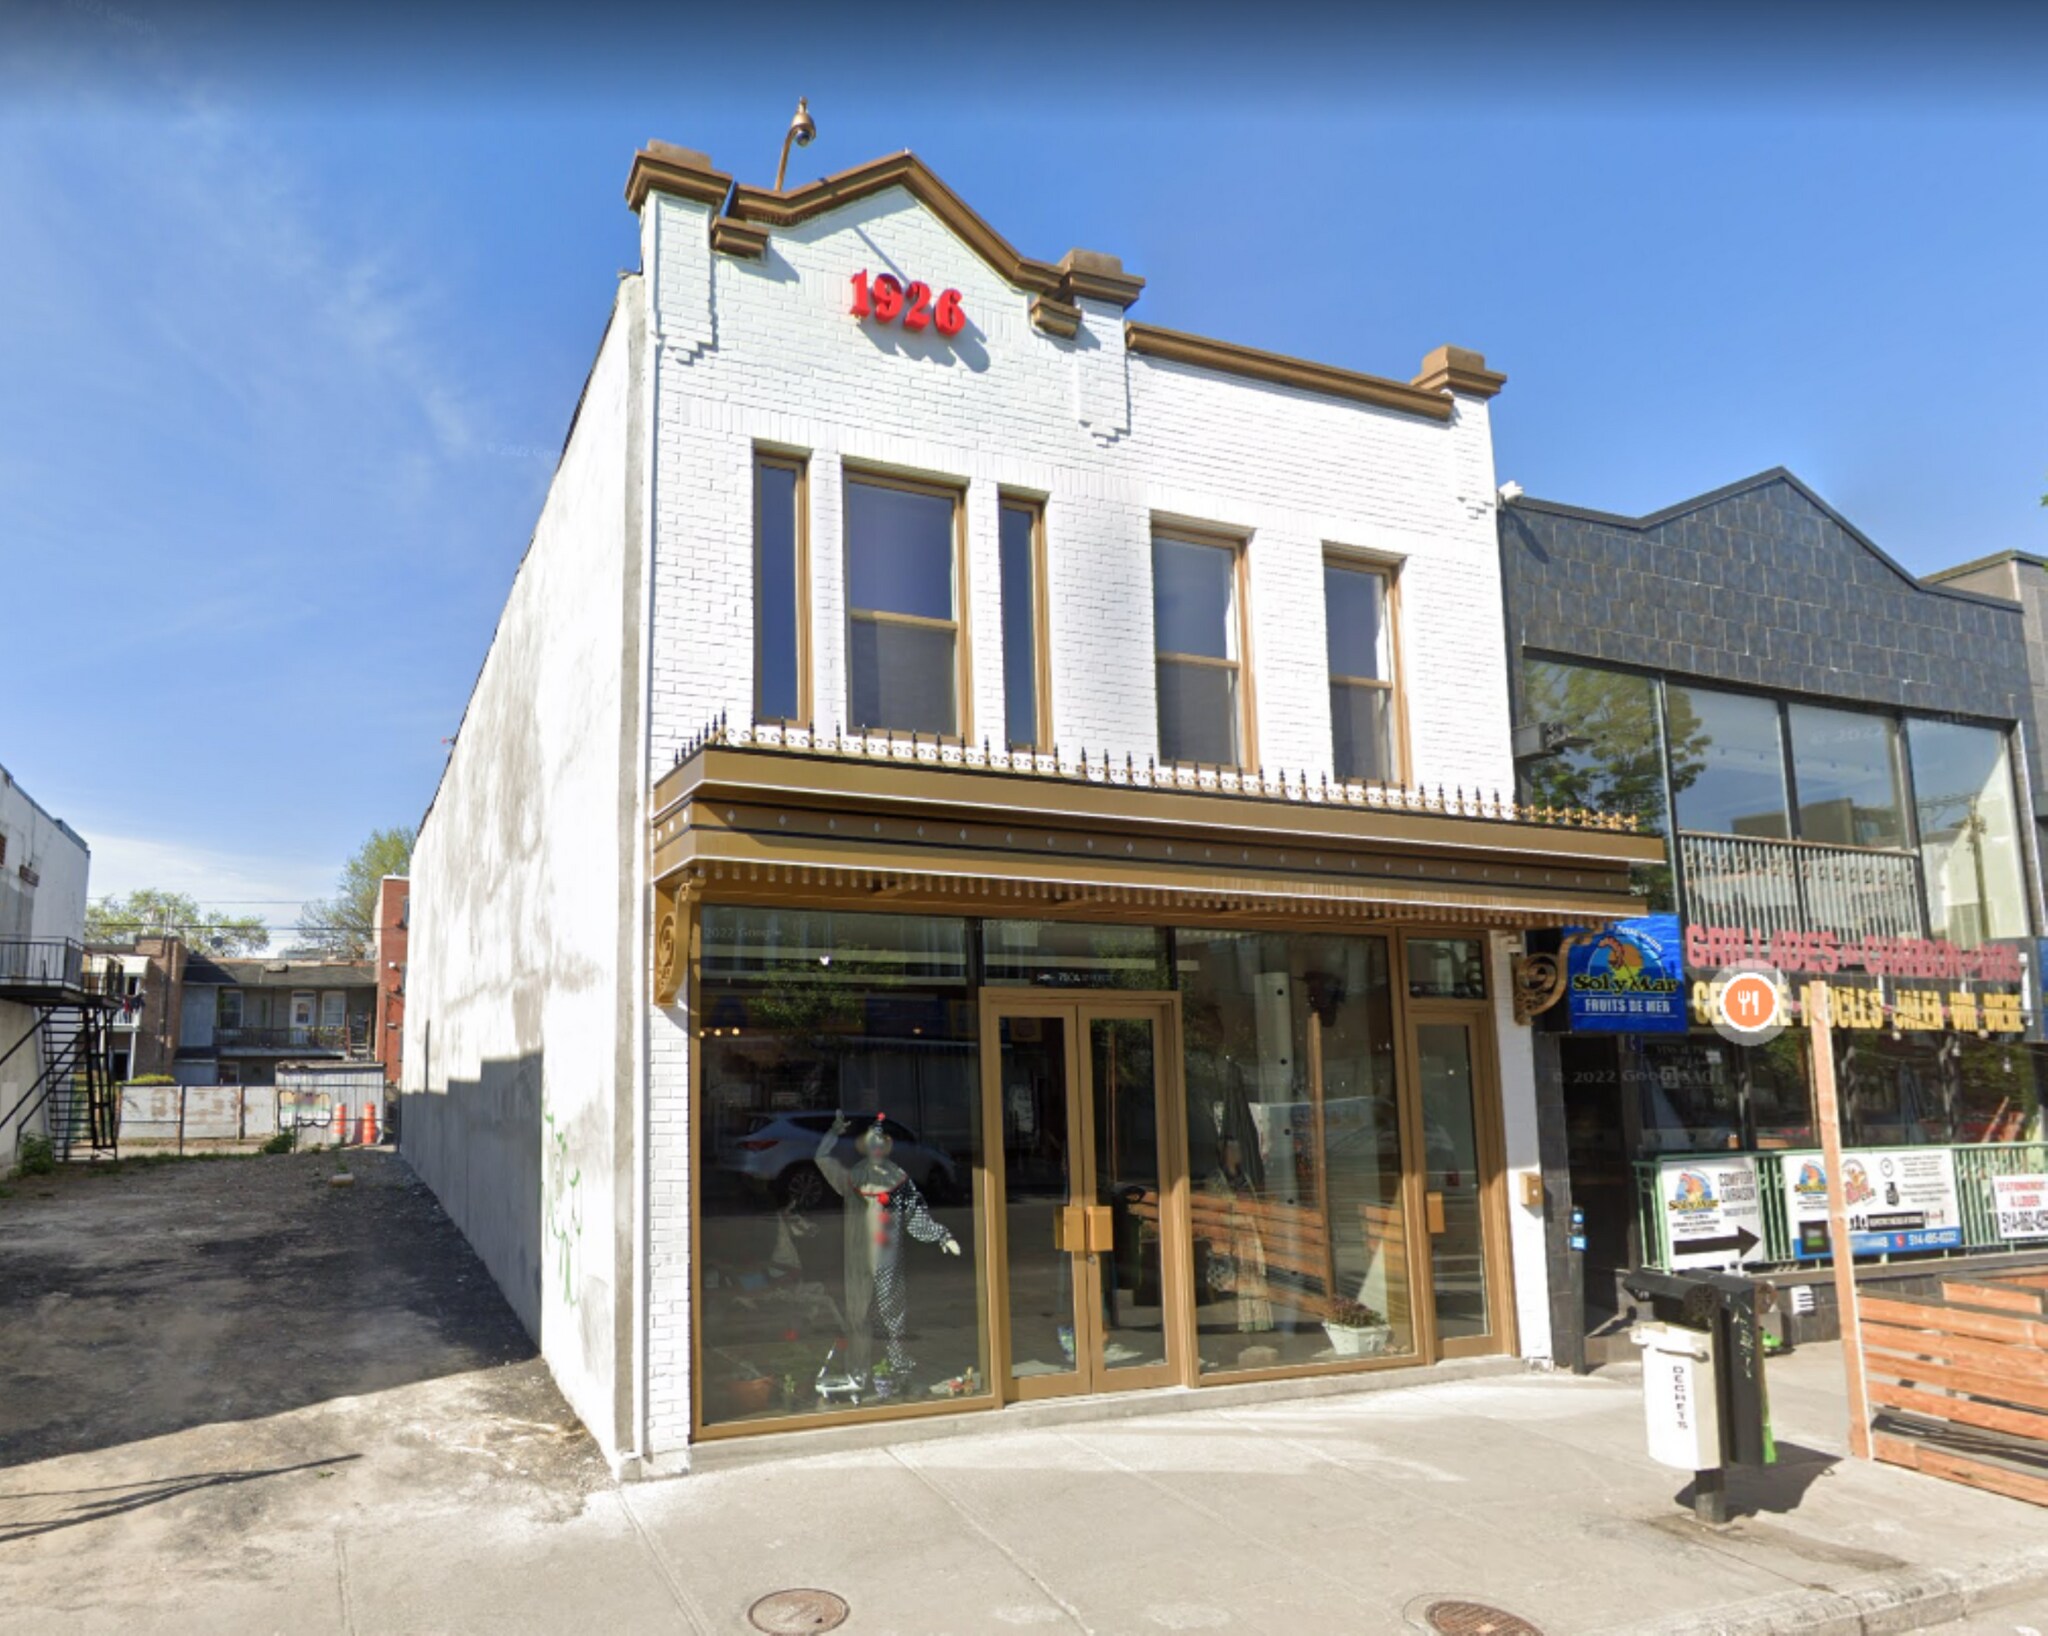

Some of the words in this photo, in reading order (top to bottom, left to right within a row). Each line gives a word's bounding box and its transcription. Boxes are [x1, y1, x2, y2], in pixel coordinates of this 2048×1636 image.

[850, 267, 966, 337] 1926
[1686, 924, 1839, 974] GRILLADES
[1863, 935, 1965, 978] CHARBON
[1585, 999, 1626, 1012] FRUITS
[1629, 1000, 1644, 1012] DE
[1646, 1001, 1671, 1013] MER
